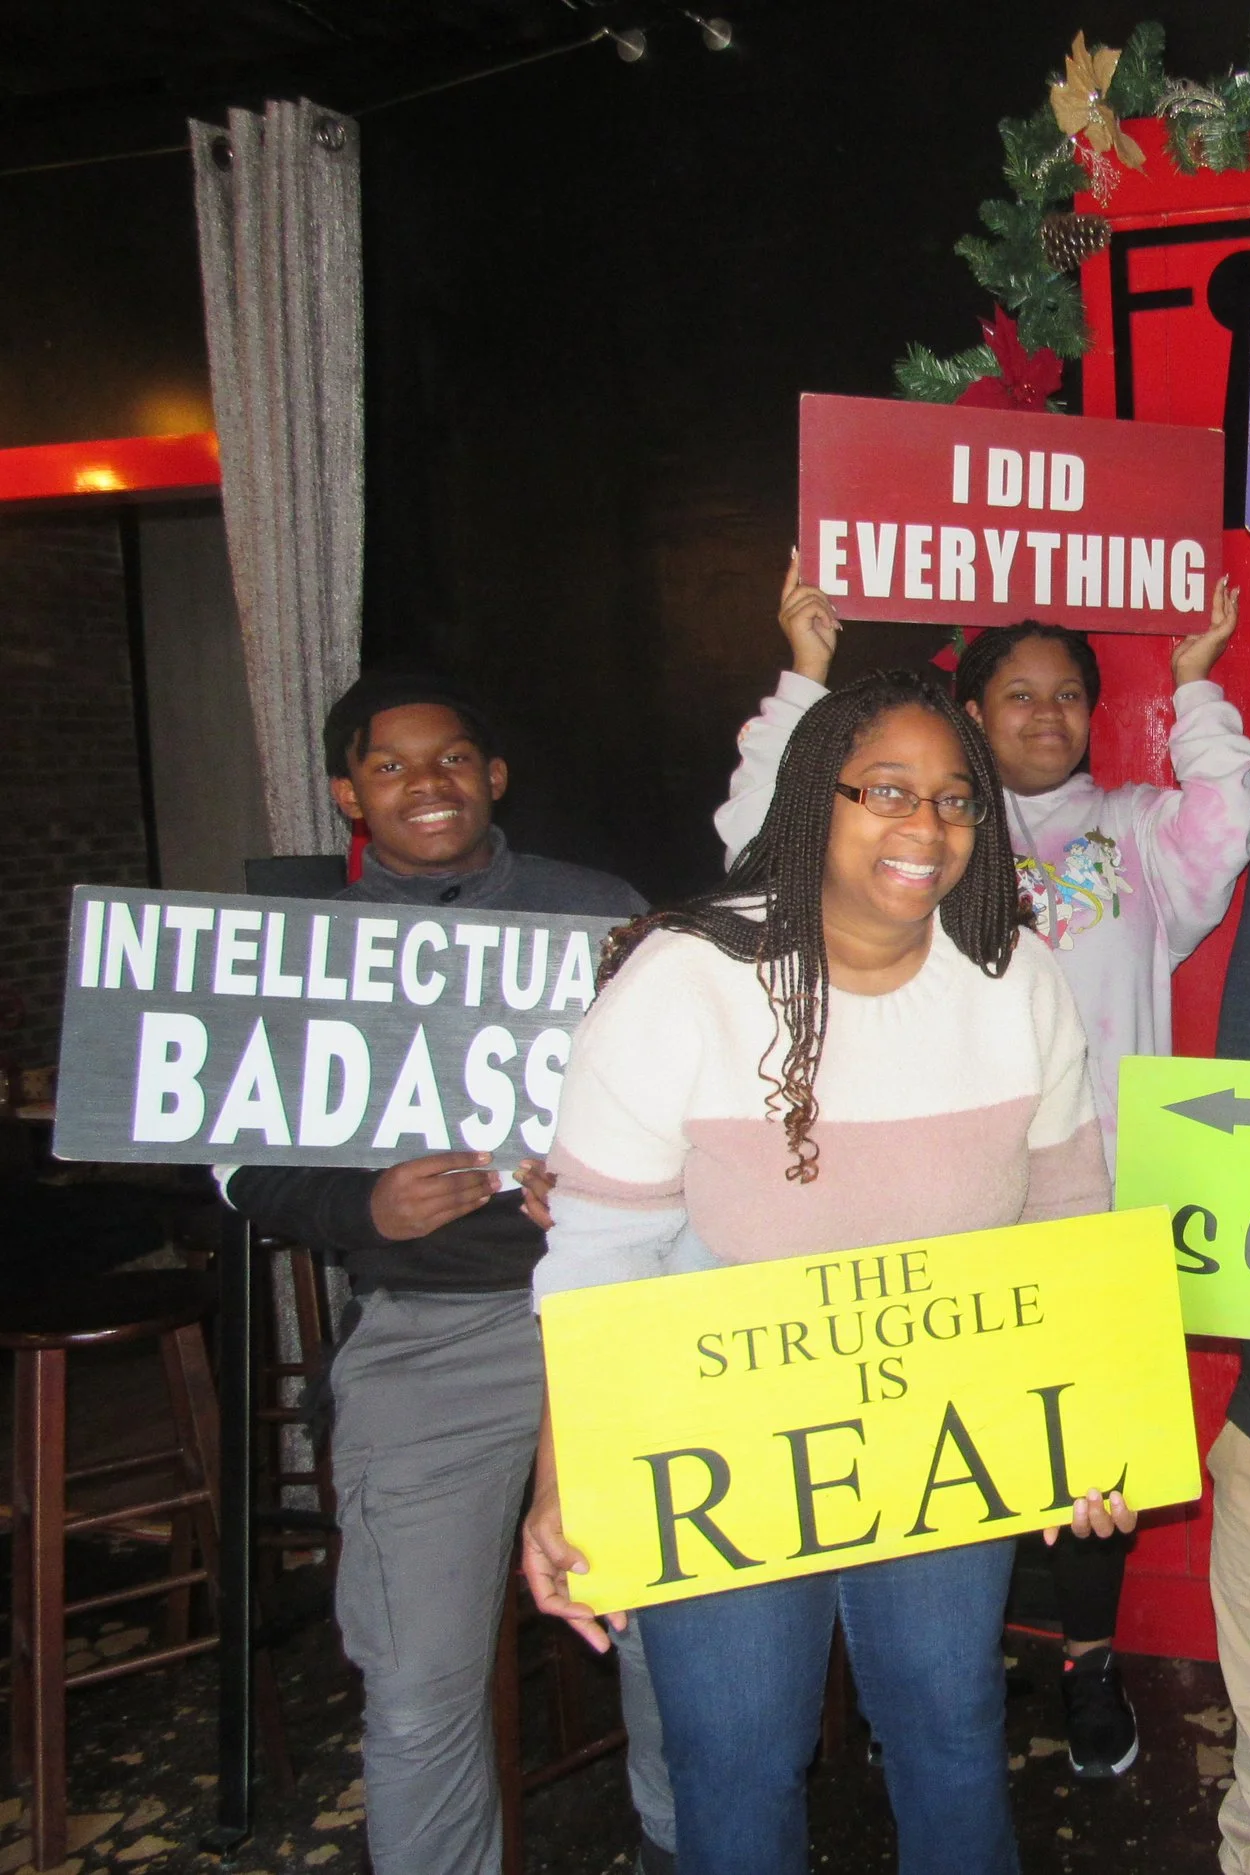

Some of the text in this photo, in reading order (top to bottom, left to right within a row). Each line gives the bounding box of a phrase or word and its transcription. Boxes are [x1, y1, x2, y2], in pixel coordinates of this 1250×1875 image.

[952, 445, 1085, 512] I DID
[819, 519, 1205, 612] EVERYTHING
[80, 901, 598, 1012] INTELLECTUA
[805, 1249, 933, 1307] THE
[696, 1283, 1045, 1379] STRUGGLE
[855, 1356, 909, 1404] IS
[632, 1382, 1128, 1588] REAL
